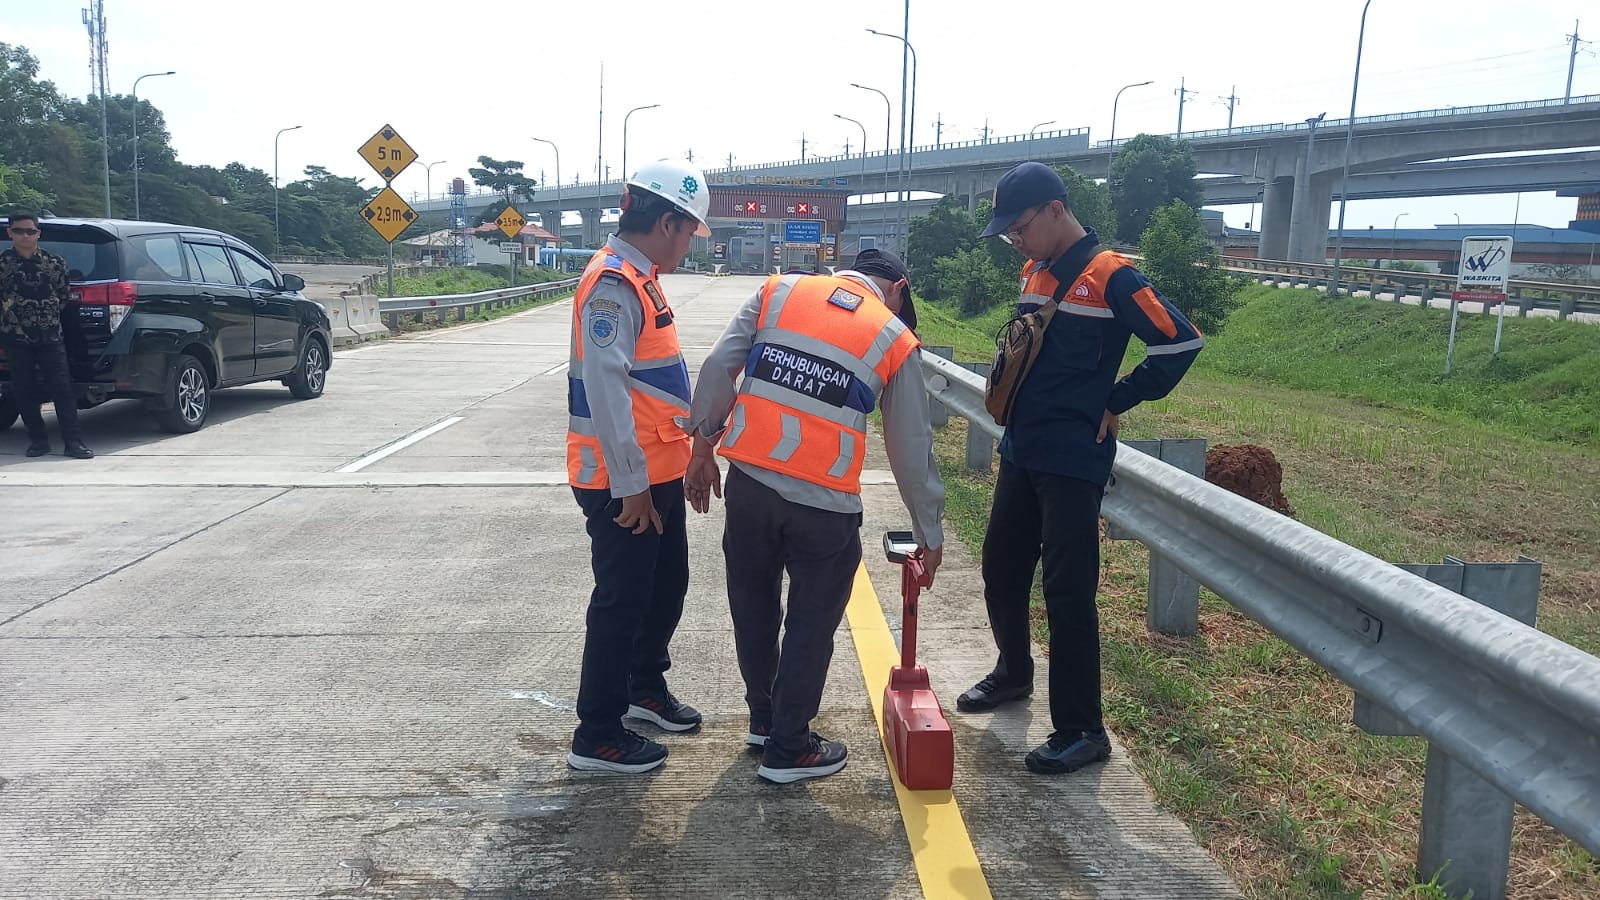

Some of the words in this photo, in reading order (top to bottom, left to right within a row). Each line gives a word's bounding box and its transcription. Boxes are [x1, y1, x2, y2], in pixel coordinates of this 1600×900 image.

[377, 146, 386, 160] 5
[391, 149, 402, 161] m
[761, 346, 851, 389] PERHUBUNGAN
[771, 366, 826, 396] DARAT
